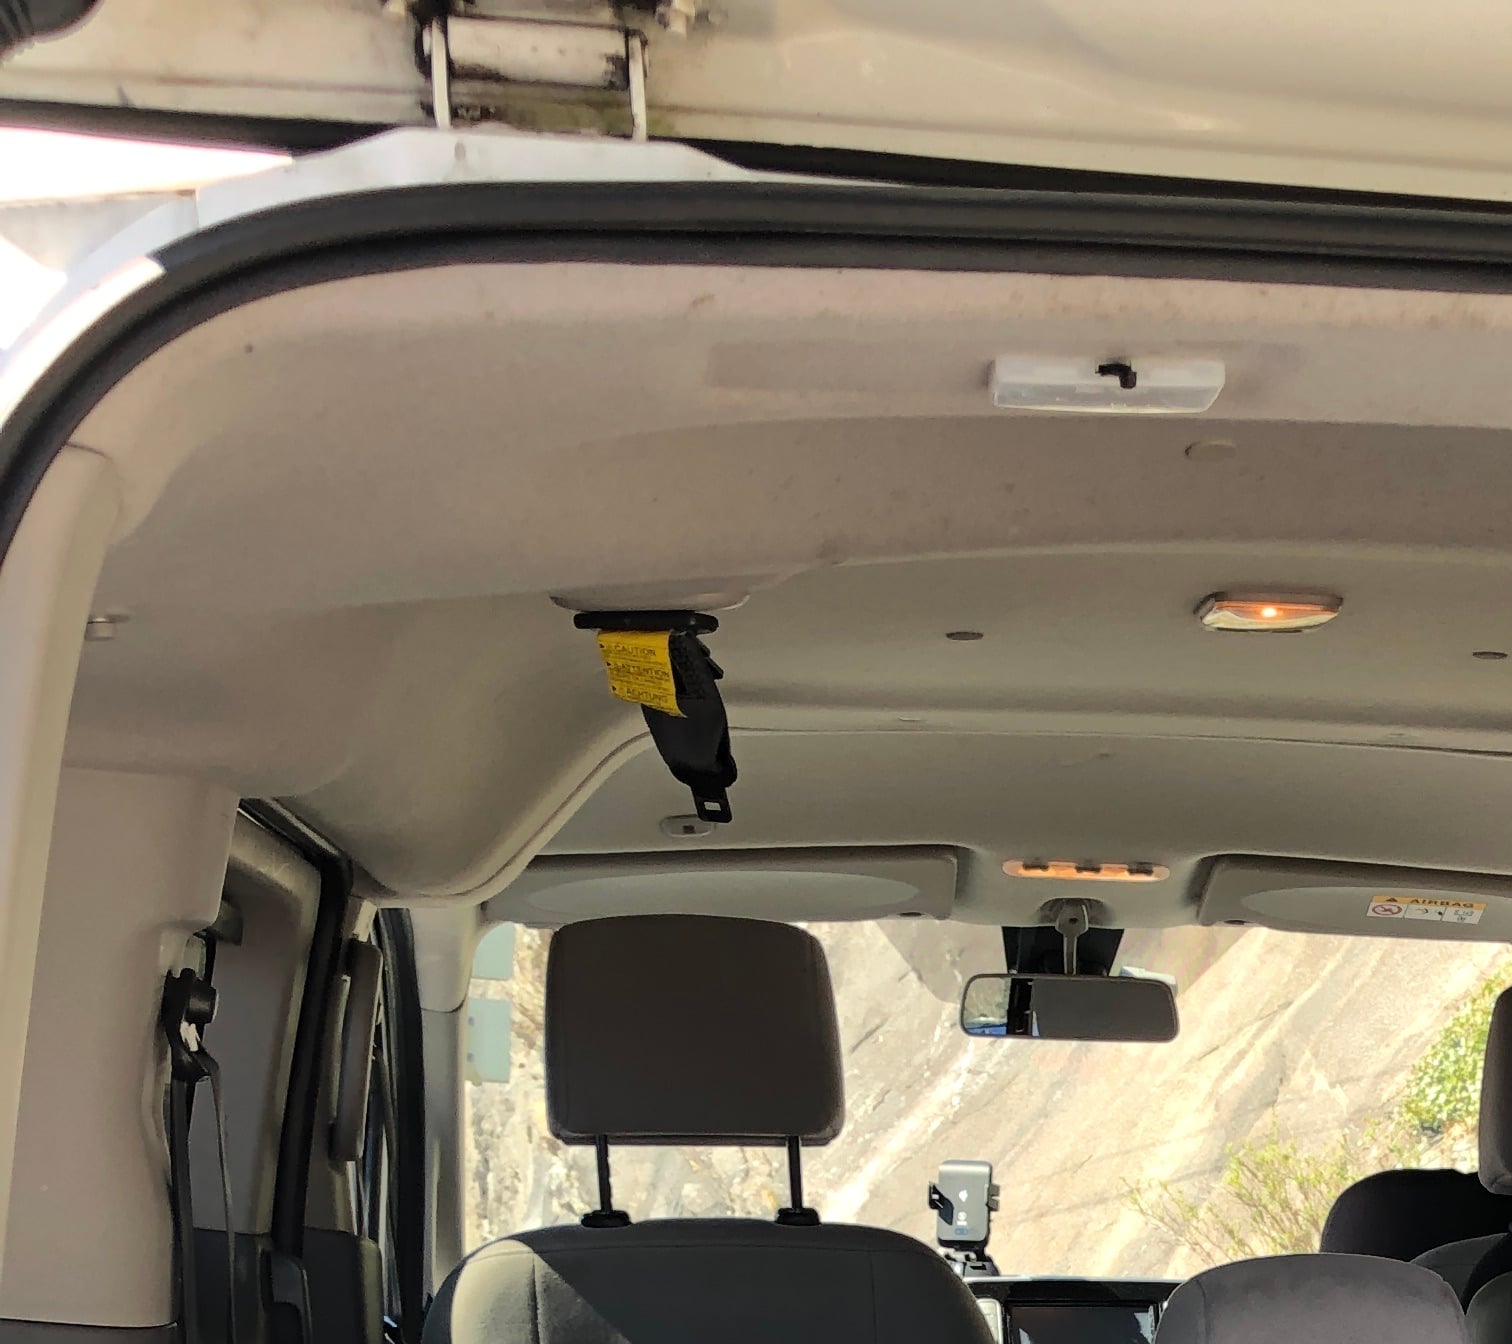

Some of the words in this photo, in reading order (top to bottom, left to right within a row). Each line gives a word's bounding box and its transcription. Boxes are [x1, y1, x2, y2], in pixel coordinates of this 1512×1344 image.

[614, 643, 657, 656] CAUTION
[620, 664, 670, 678] ATTENTION
[626, 687, 669, 703] ACHTUNG
[1410, 898, 1475, 909] AIRBAG
